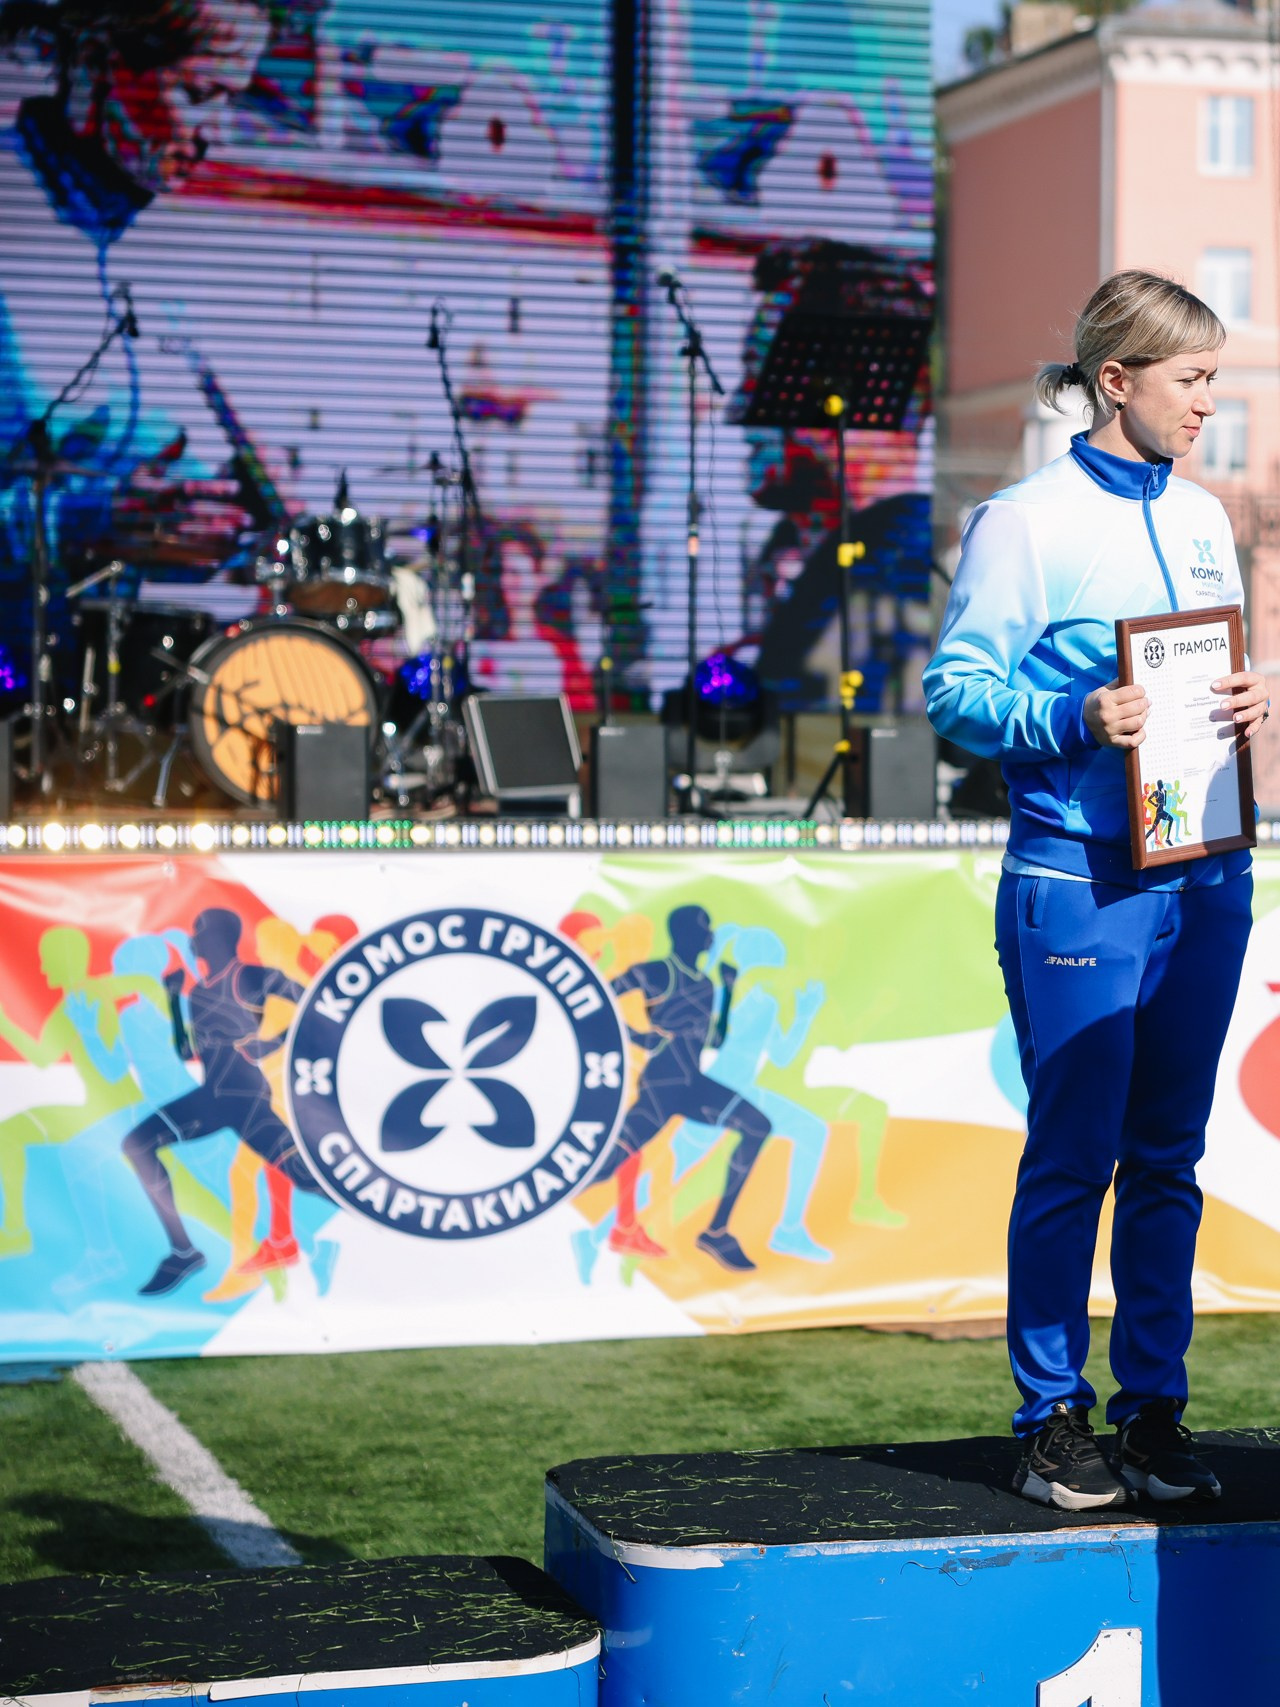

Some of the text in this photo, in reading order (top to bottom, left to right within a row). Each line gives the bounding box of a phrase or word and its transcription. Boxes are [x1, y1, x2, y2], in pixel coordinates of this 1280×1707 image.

[1173, 637, 1227, 656] ГРАМОТА
[315, 914, 603, 1023] КОМОС ГРУПП
[1046, 956, 1096, 966] FANLIFE
[317, 1120, 605, 1231] СПАРТАКИАДА
